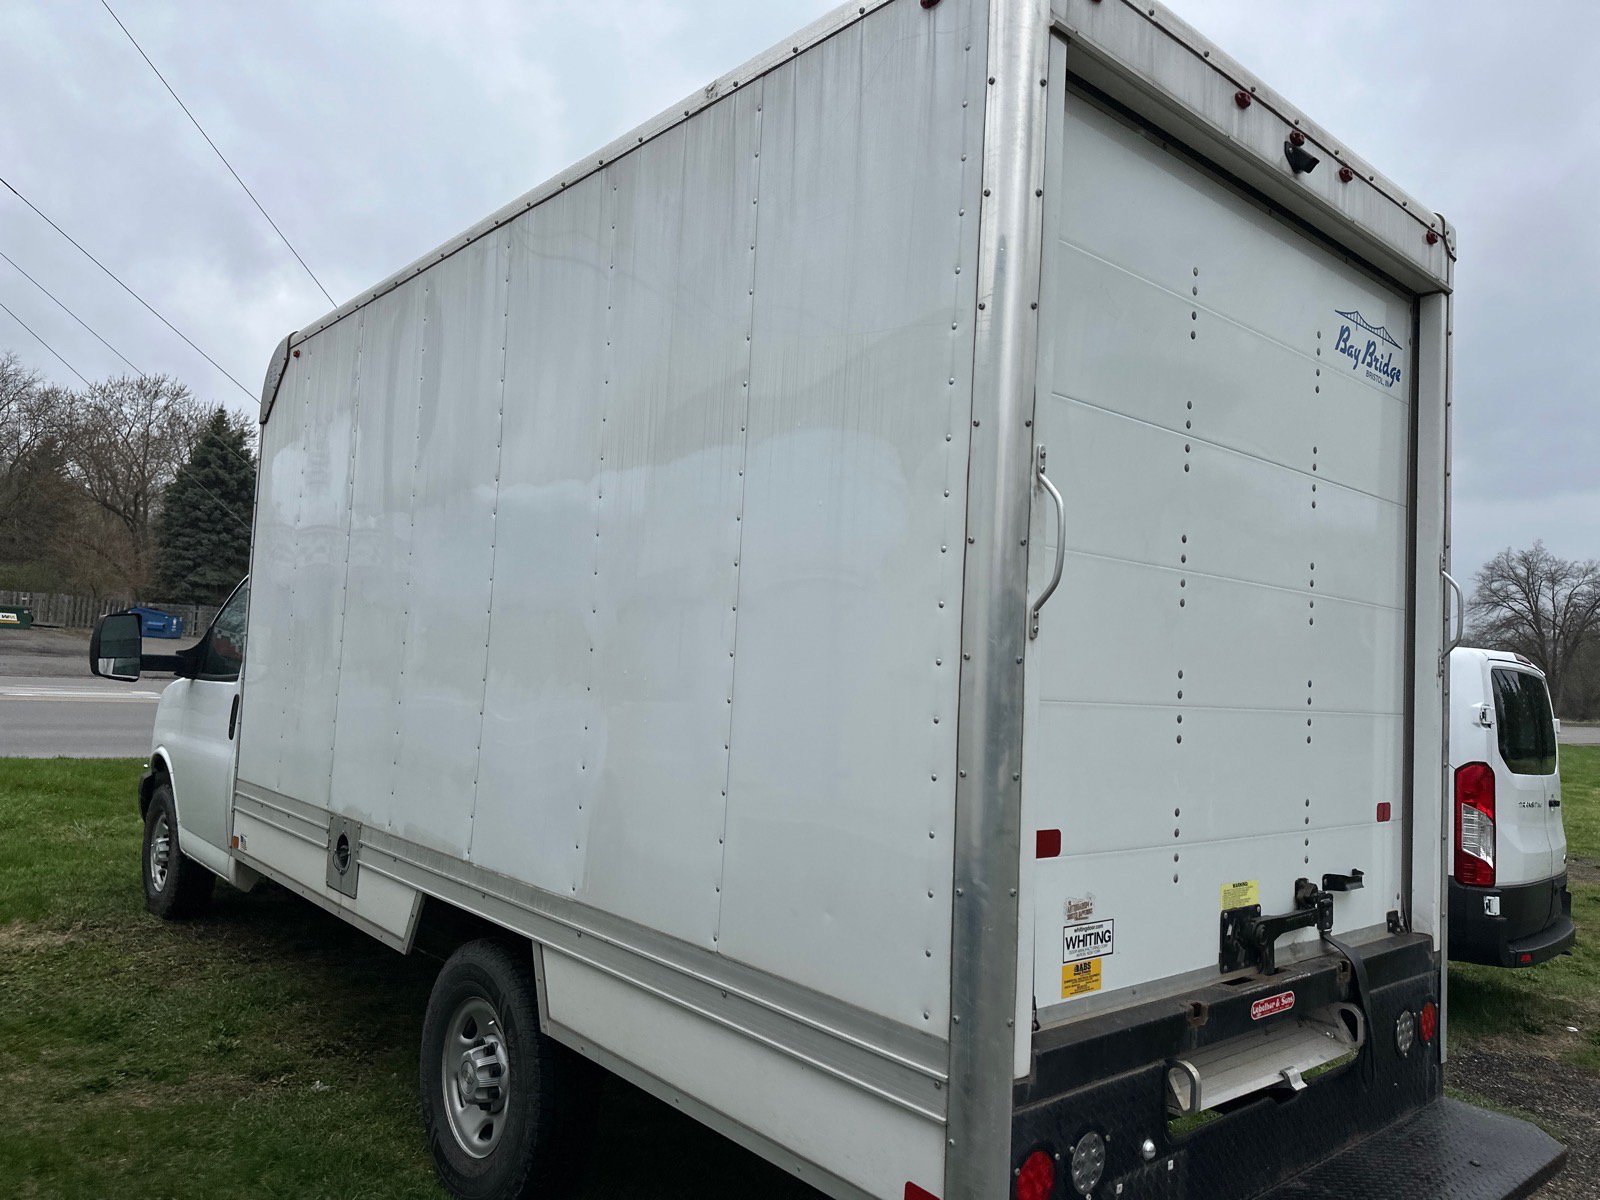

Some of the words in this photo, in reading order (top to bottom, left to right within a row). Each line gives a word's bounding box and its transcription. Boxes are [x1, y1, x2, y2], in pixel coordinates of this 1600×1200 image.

[1335, 325, 1361, 370] Bay
[1361, 340, 1401, 387] Bridge
[1074, 924, 1103, 933] whitingdoor.com
[1065, 930, 1111, 950] WHITING
[1276, 998, 1281, 1007] &
